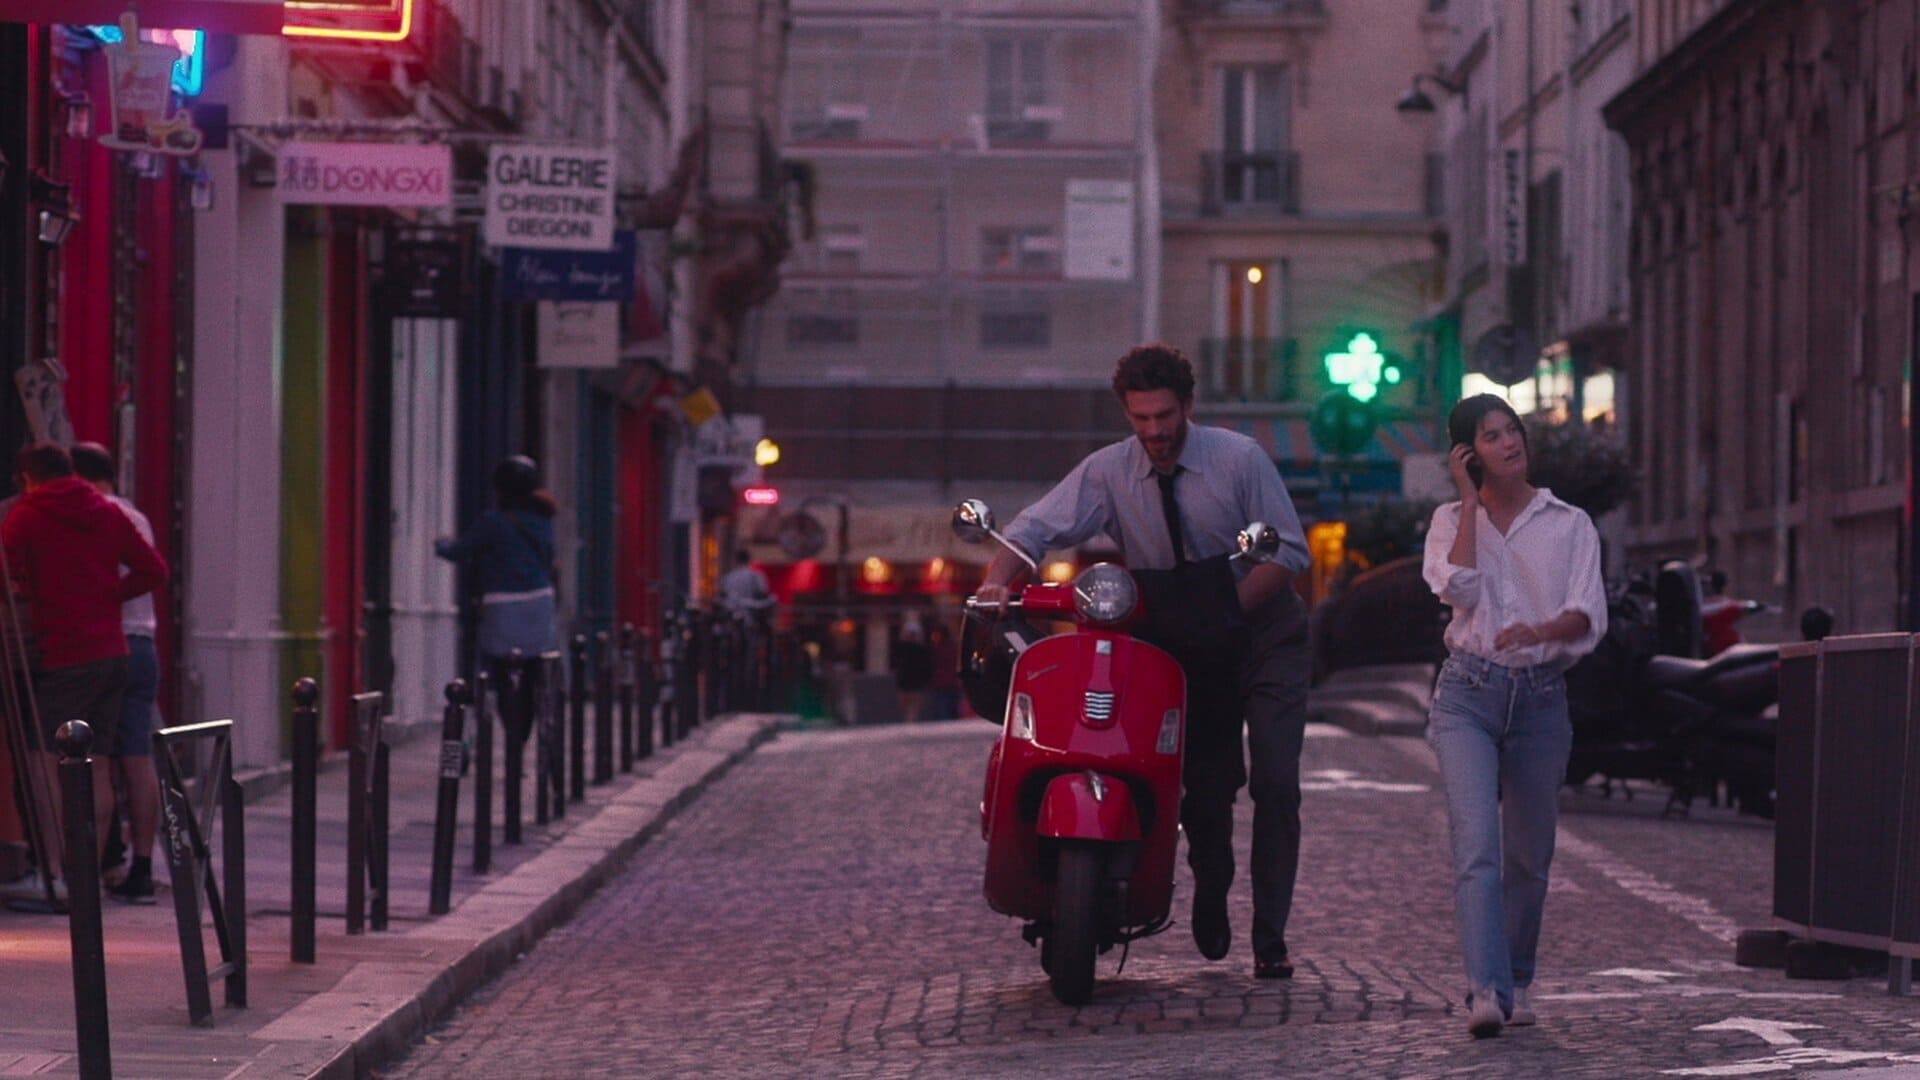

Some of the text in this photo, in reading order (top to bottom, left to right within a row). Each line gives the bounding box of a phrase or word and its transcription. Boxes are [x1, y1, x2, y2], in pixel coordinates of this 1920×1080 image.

[496, 154, 608, 189] GALERIE
[498, 193, 605, 215] CHRISTINE
[506, 217, 592, 237] DIEGONI
